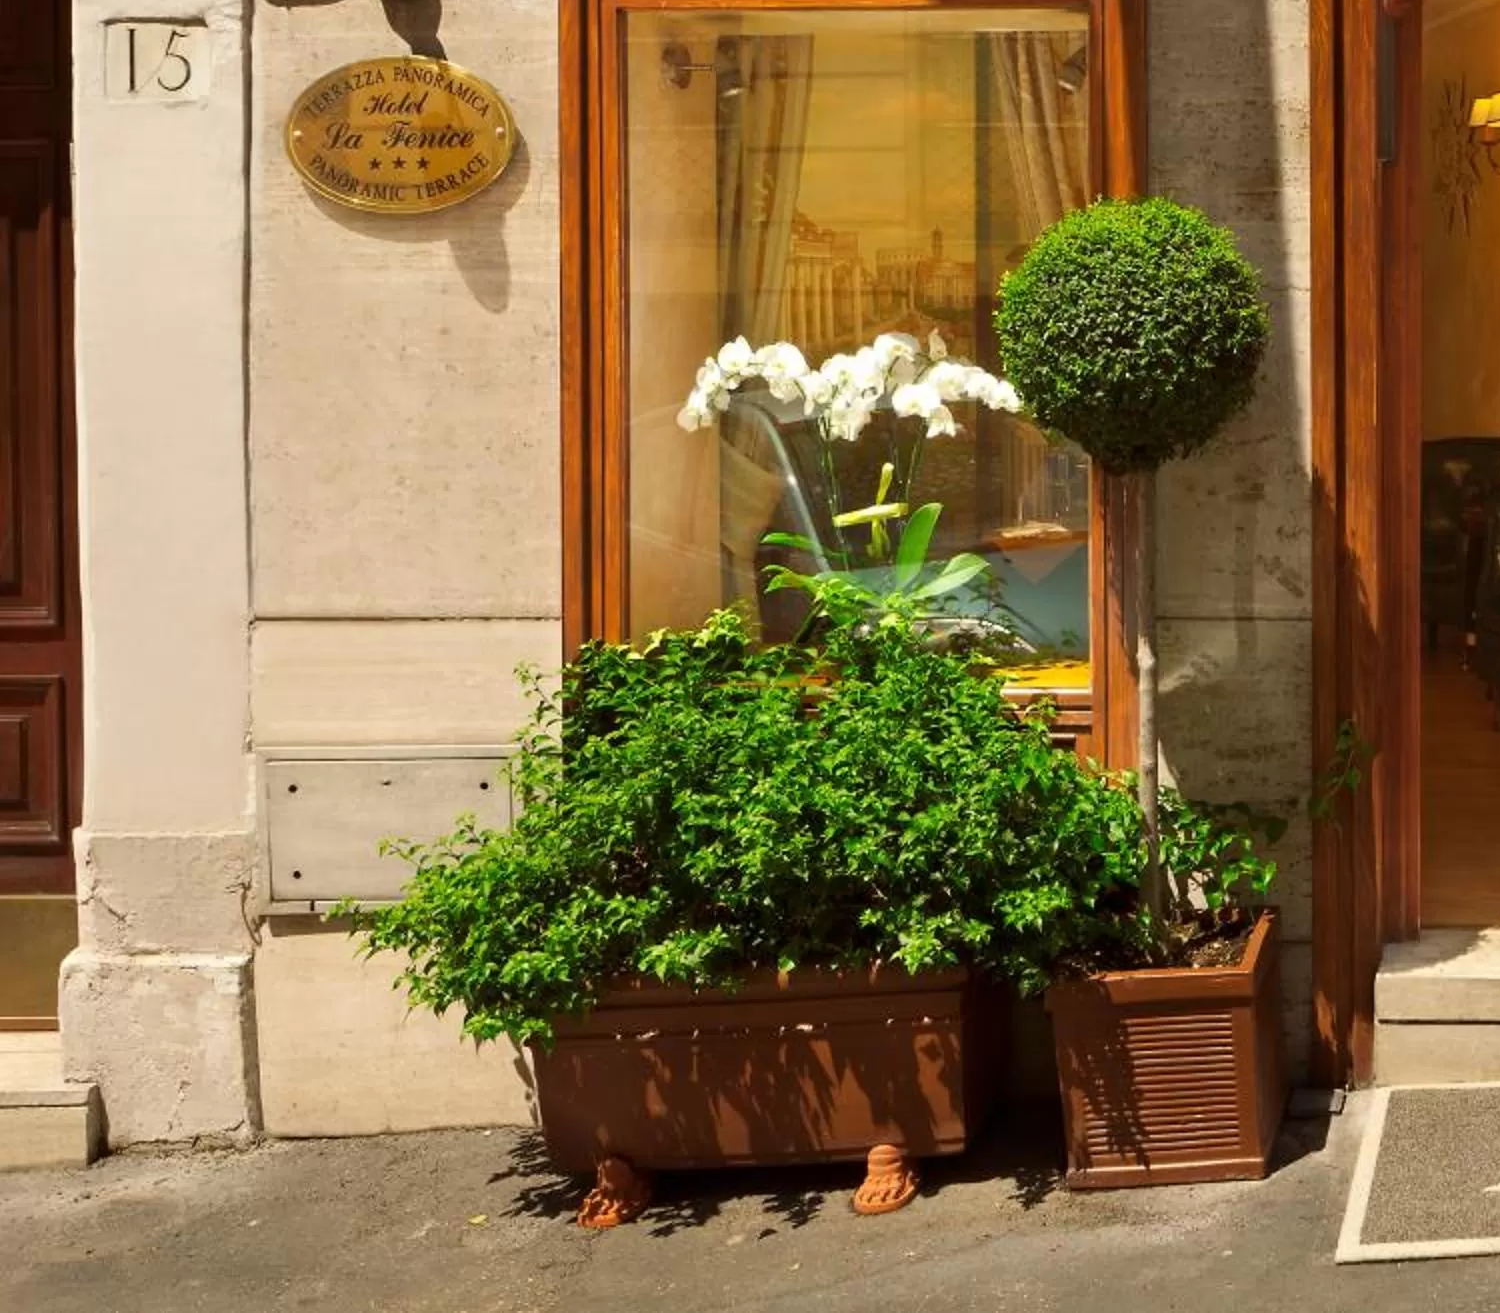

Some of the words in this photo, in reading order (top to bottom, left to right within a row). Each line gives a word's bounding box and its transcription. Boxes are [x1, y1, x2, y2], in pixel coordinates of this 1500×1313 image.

[127, 27, 192, 94] 15
[303, 69, 386, 119] TERRAZZA
[394, 66, 491, 118] PANORAMICA
[363, 91, 429, 116] Hotel
[322, 119, 365, 150] La
[380, 119, 476, 149] Fenice
[308, 153, 406, 202] PANORAMIC
[416, 151, 490, 200] TERRACE
